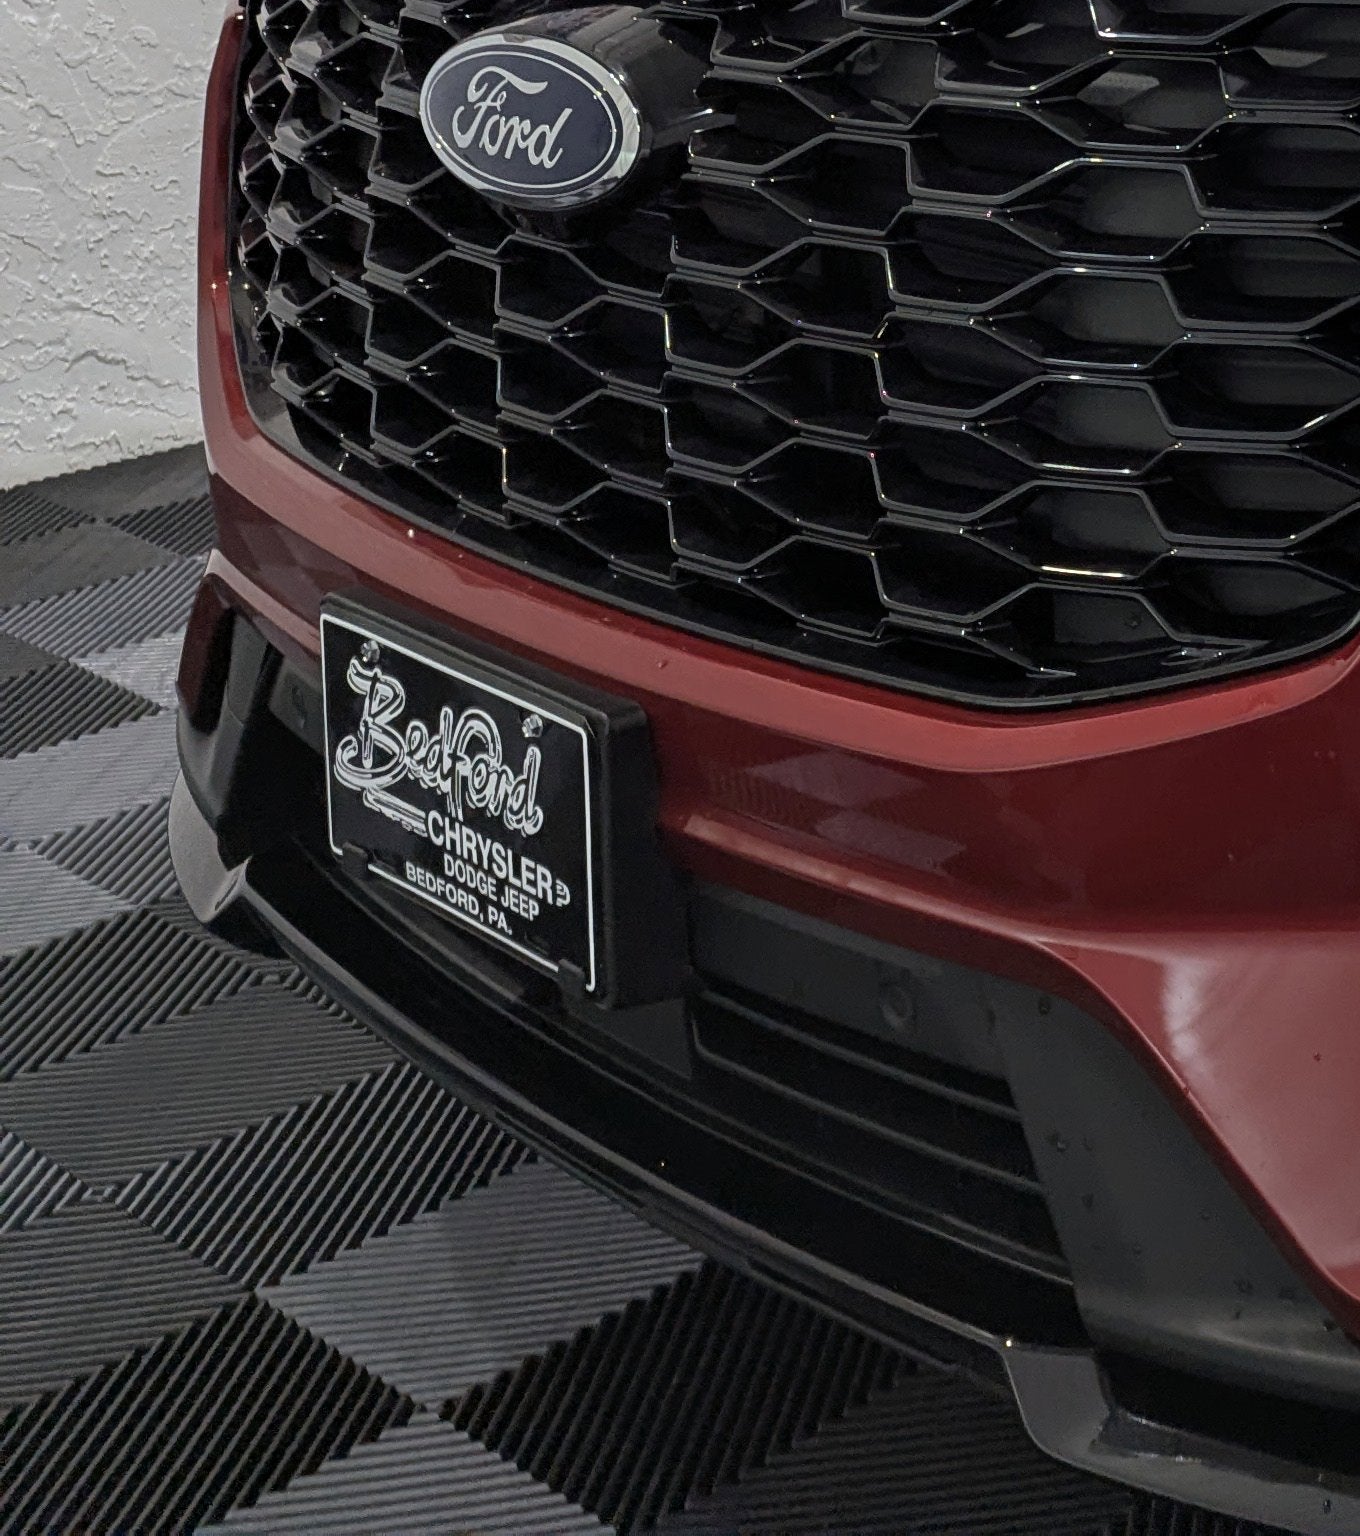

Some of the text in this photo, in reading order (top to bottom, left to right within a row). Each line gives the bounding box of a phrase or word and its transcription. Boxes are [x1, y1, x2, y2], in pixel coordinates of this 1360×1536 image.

[452, 65, 573, 169] Ford
[334, 657, 544, 838] Bedford
[405, 861, 513, 936] BEDFORD, PA.
[427, 809, 553, 906] CHRYSLER
[443, 853, 540, 921] DODGE JEEP
